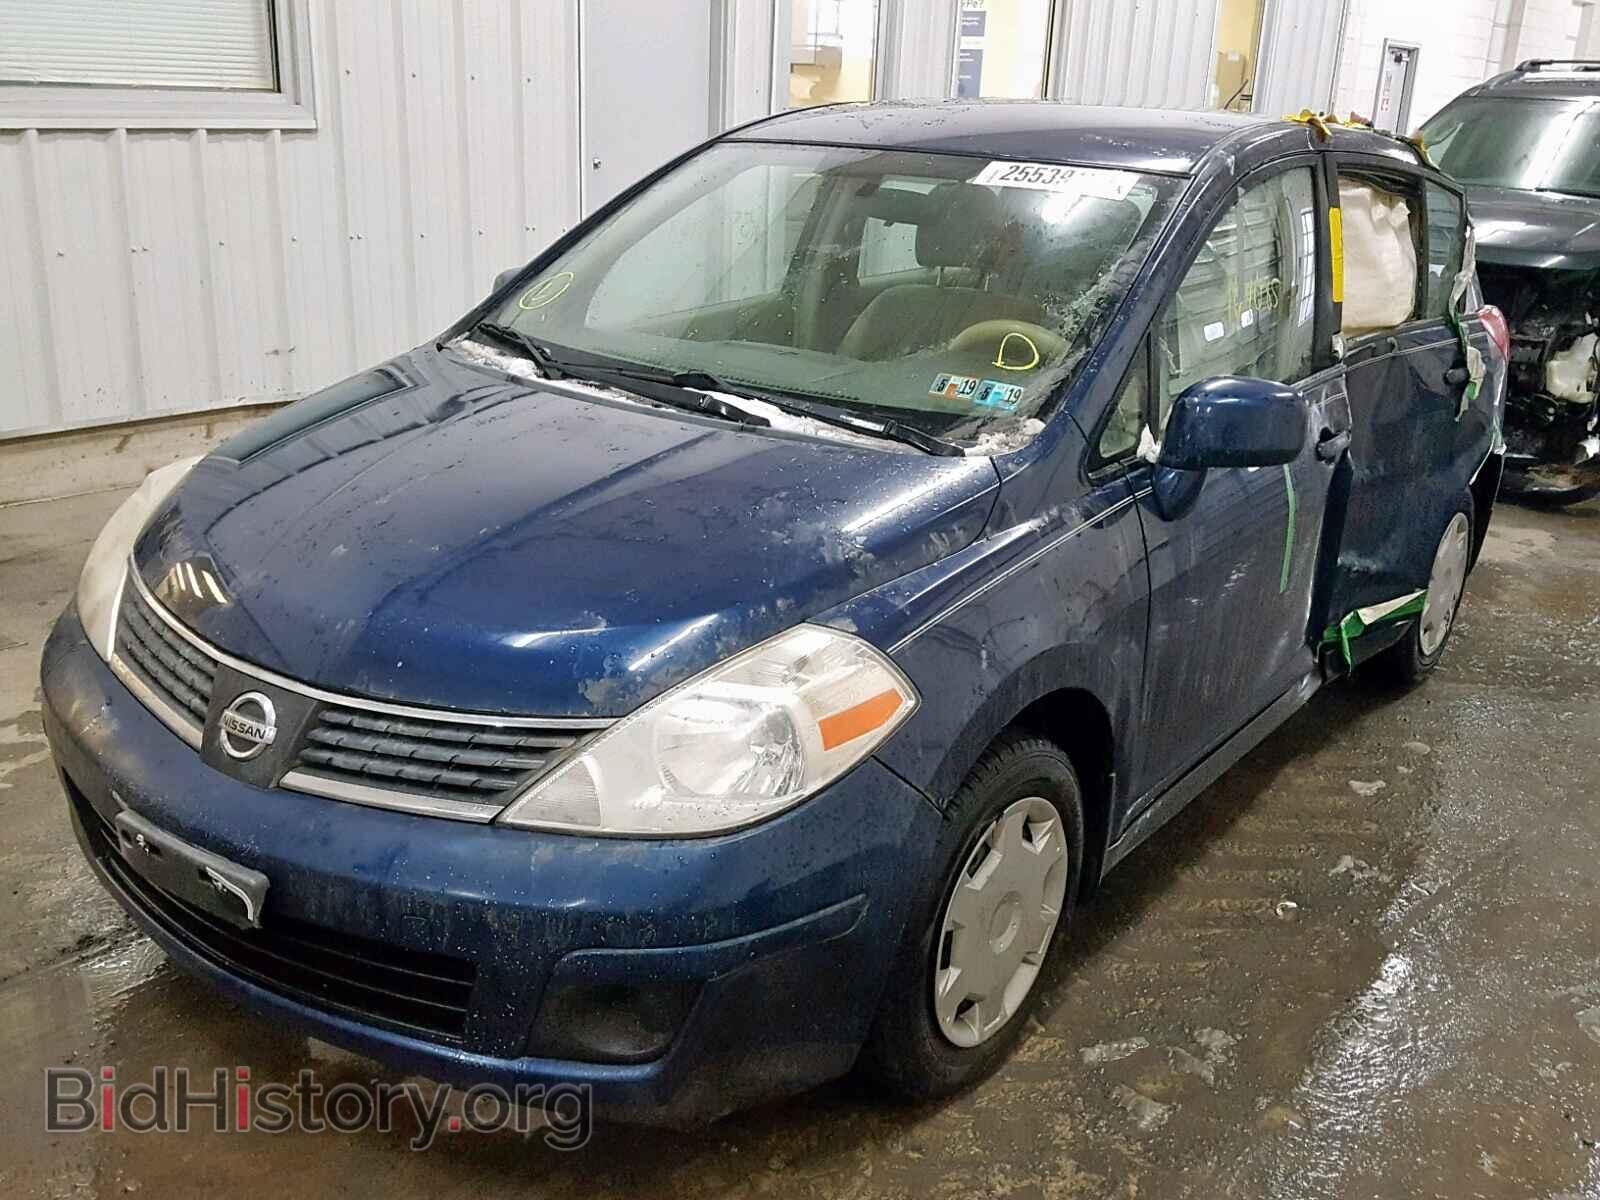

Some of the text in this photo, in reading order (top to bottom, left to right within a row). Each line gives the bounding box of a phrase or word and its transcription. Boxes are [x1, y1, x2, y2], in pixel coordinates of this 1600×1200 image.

[959, 379, 977, 395] 19
[1007, 388, 1022, 405] 19
[222, 714, 267, 740] NISSAN
